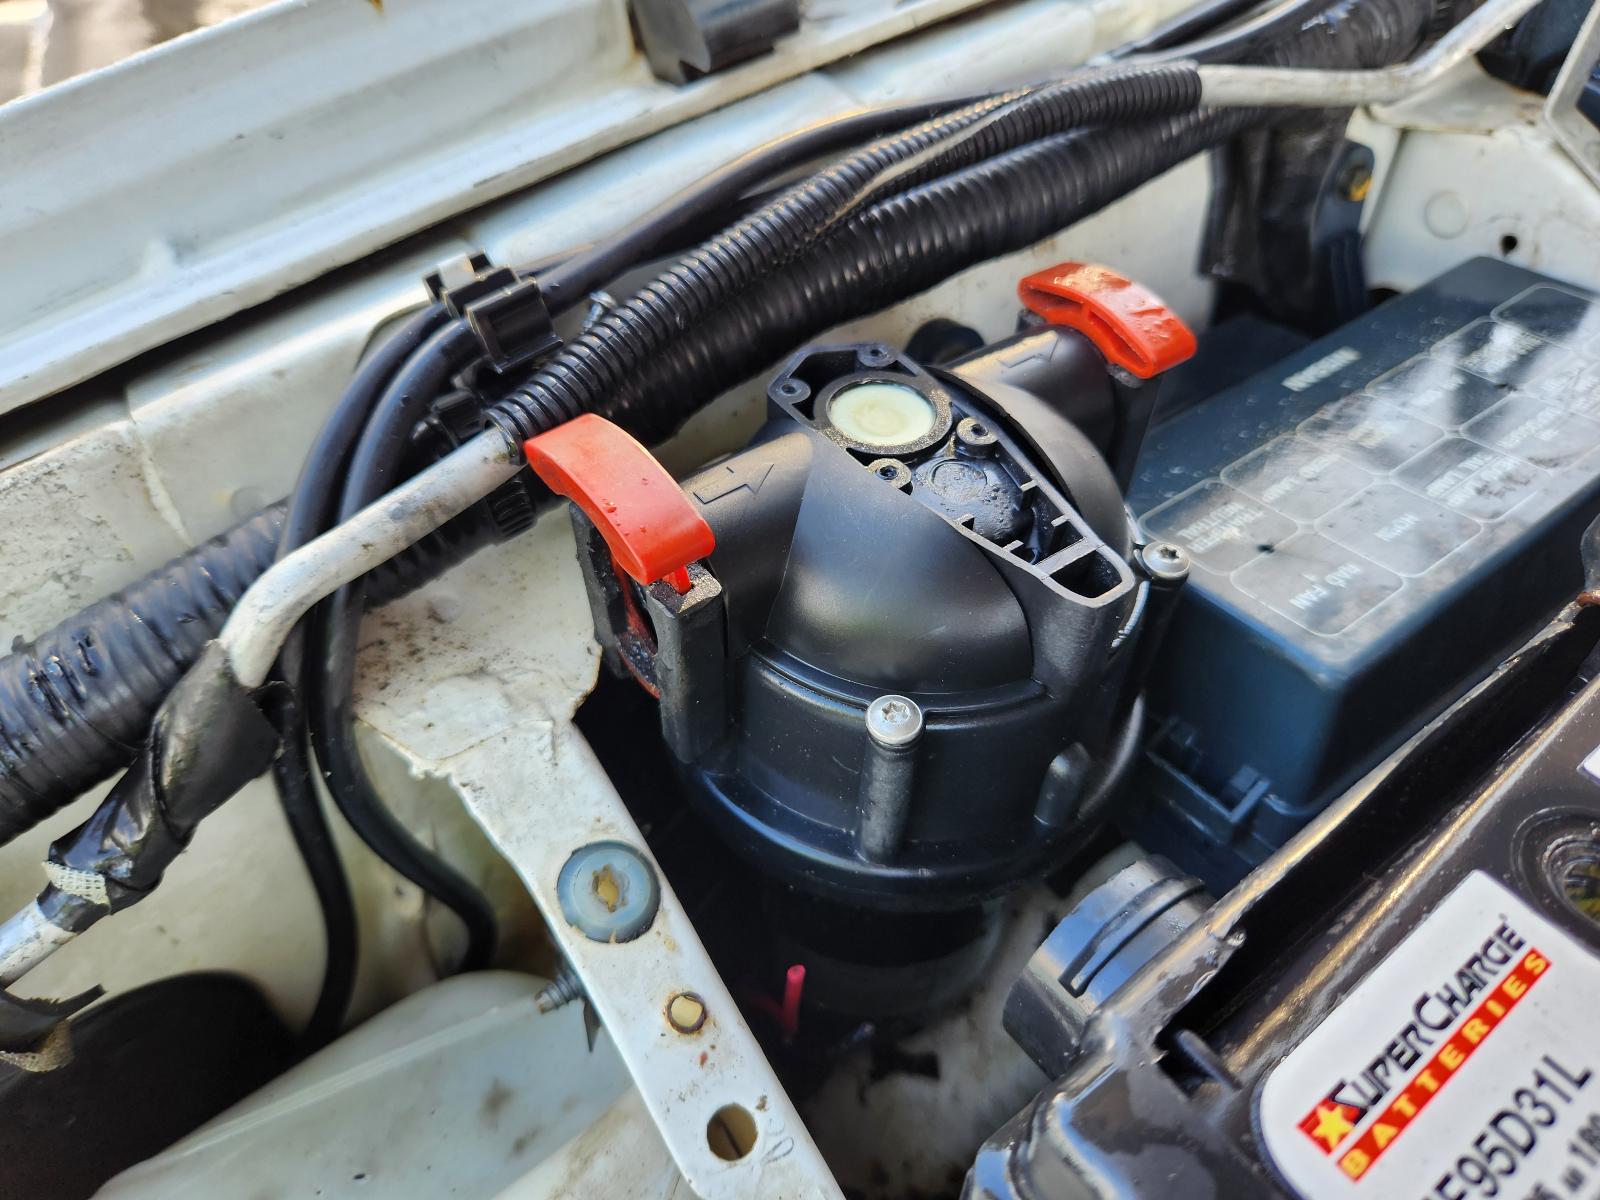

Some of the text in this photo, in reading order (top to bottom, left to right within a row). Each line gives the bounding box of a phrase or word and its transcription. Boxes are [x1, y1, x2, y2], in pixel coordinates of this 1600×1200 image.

[1289, 562, 1361, 610] RAD FAN
[1341, 952, 1548, 1177] BATTERIES
[1423, 1055, 1593, 1200] F95D31L
